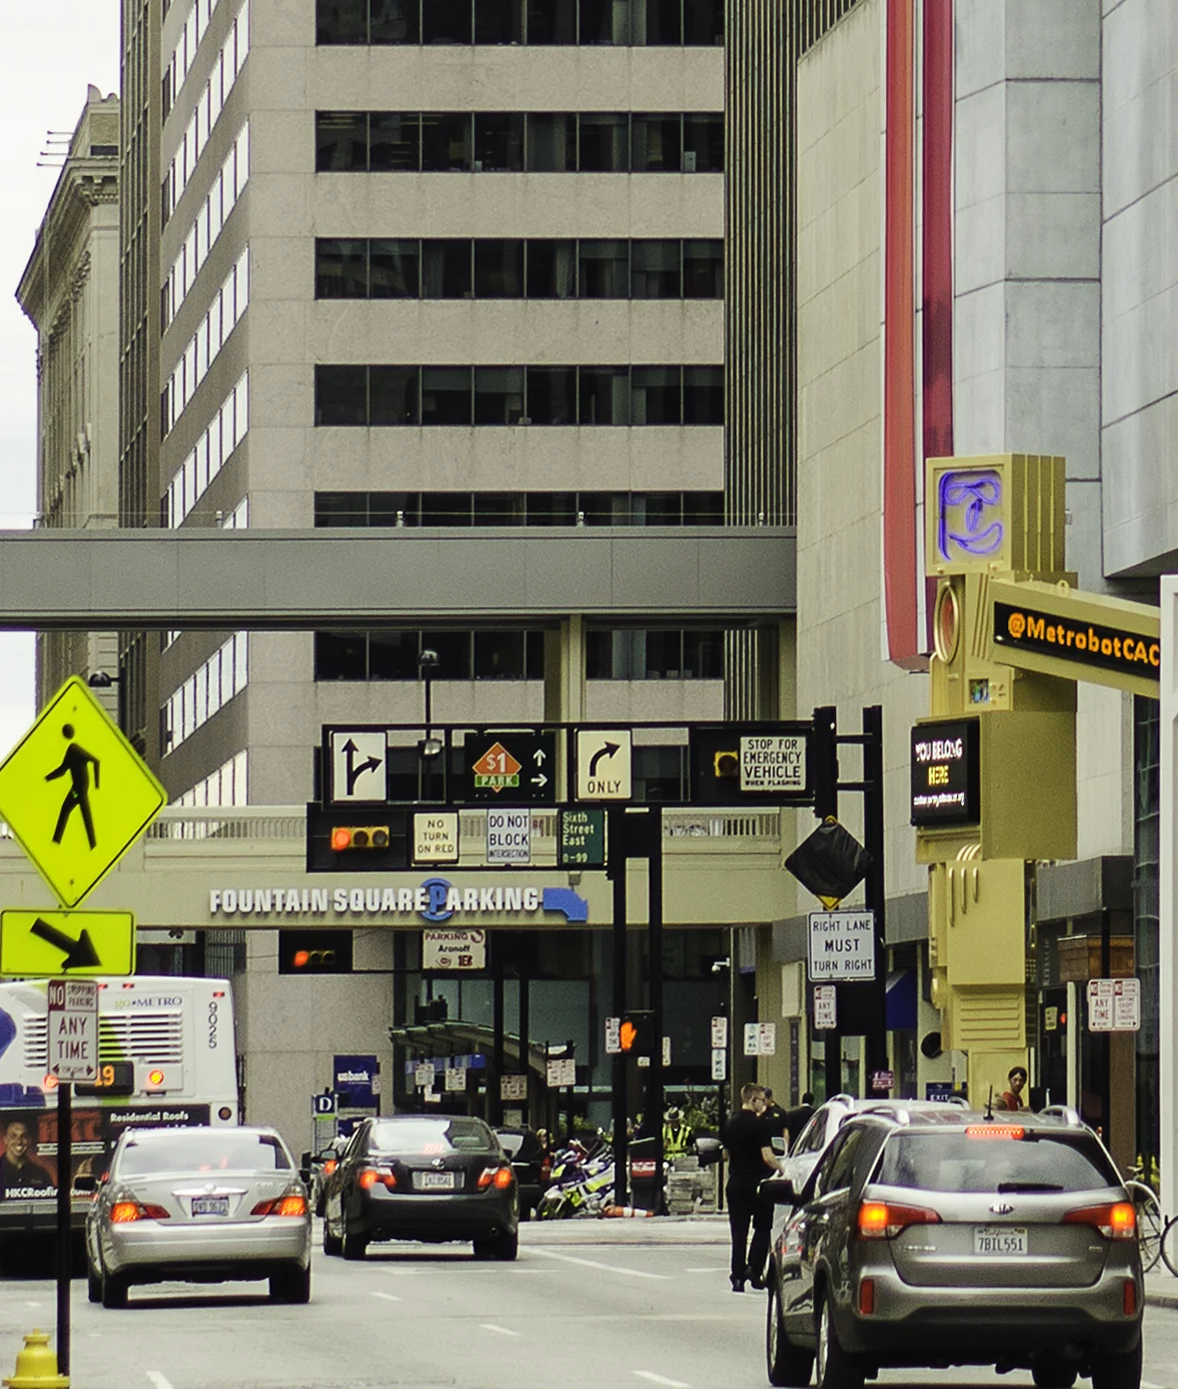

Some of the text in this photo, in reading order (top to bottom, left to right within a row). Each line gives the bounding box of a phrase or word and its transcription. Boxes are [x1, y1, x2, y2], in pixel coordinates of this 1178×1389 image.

[748, 739, 797, 749] STOP FOR
[915, 738, 962, 761] YOU BELONG
[486, 752, 506, 773] $1
[744, 751, 801, 764] EMERGENCY
[744, 766, 801, 778] VEHICLE
[928, 765, 949, 785] HERE
[481, 775, 514, 785] PARK
[587, 781, 621, 793] ONLY
[490, 815, 528, 827] DO NOT
[563, 812, 587, 823] Sixth
[563, 824, 594, 834] Street
[423, 832, 448, 840] TURN
[490, 834, 528, 846] BLOCK
[563, 835, 585, 846] East
[209, 888, 328, 913] FOUNTAIN
[333, 887, 426, 912] SQUARE
[813, 920, 871, 932] RIGHT LANE
[426, 932, 468, 940] PARKING
[825, 939, 860, 952] MUST
[814, 959, 872, 971] TURN RIGHT
[50, 985, 65, 1006] NO
[59, 1018, 87, 1035] ANY
[57, 1041, 88, 1060] TIME
[319, 1097, 332, 1111] D
[110, 1111, 189, 1122] Residential Roofs
